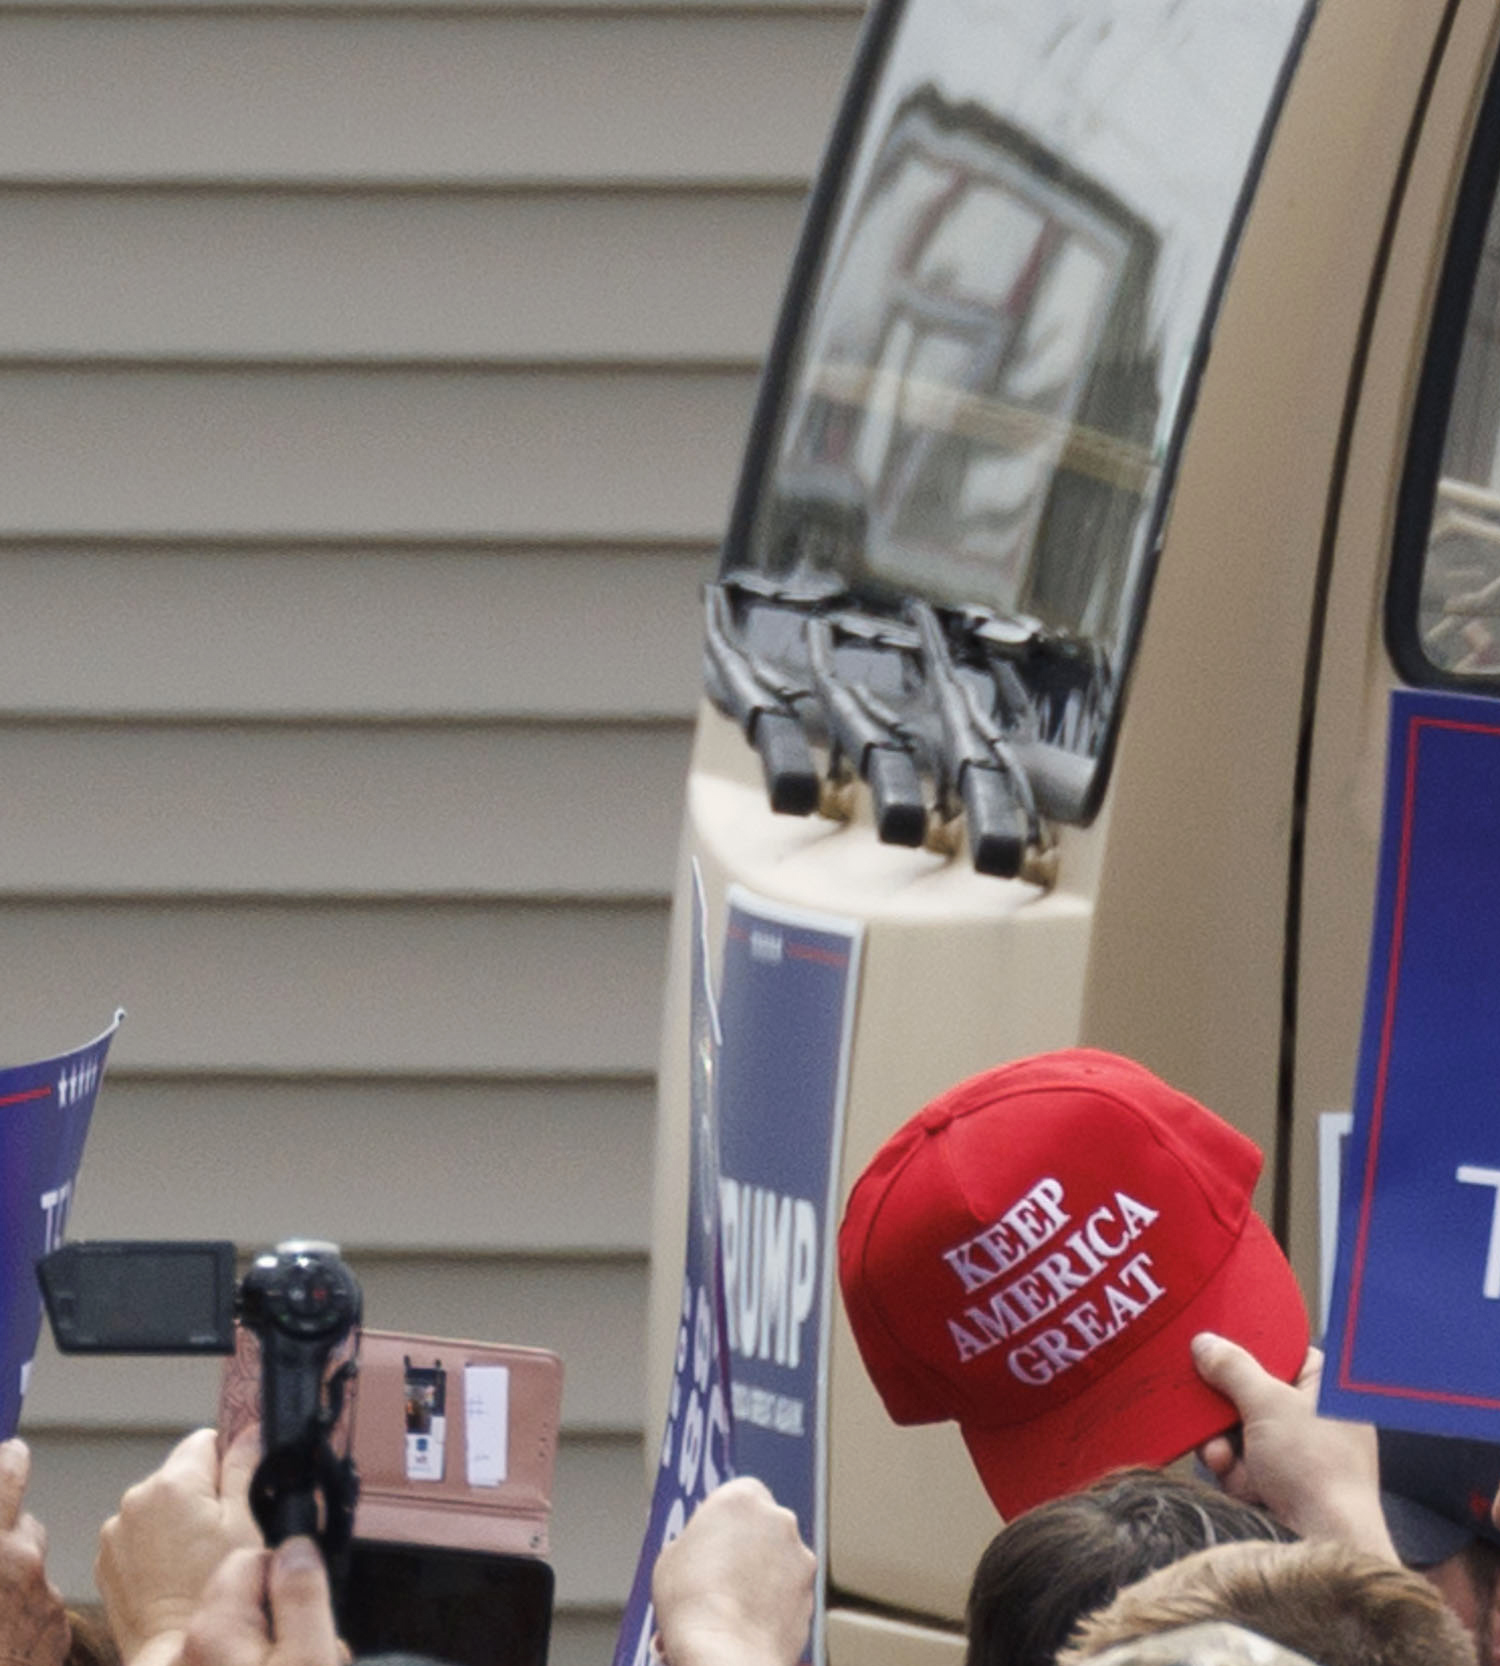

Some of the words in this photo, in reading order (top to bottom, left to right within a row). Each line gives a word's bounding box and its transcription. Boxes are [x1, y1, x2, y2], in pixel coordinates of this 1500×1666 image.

[719, 1176, 817, 1369] RUMP
[943, 1178, 1071, 1294] KEEP
[946, 1191, 1160, 1363] AMERICA
[1007, 1252, 1166, 1385] GREAT
